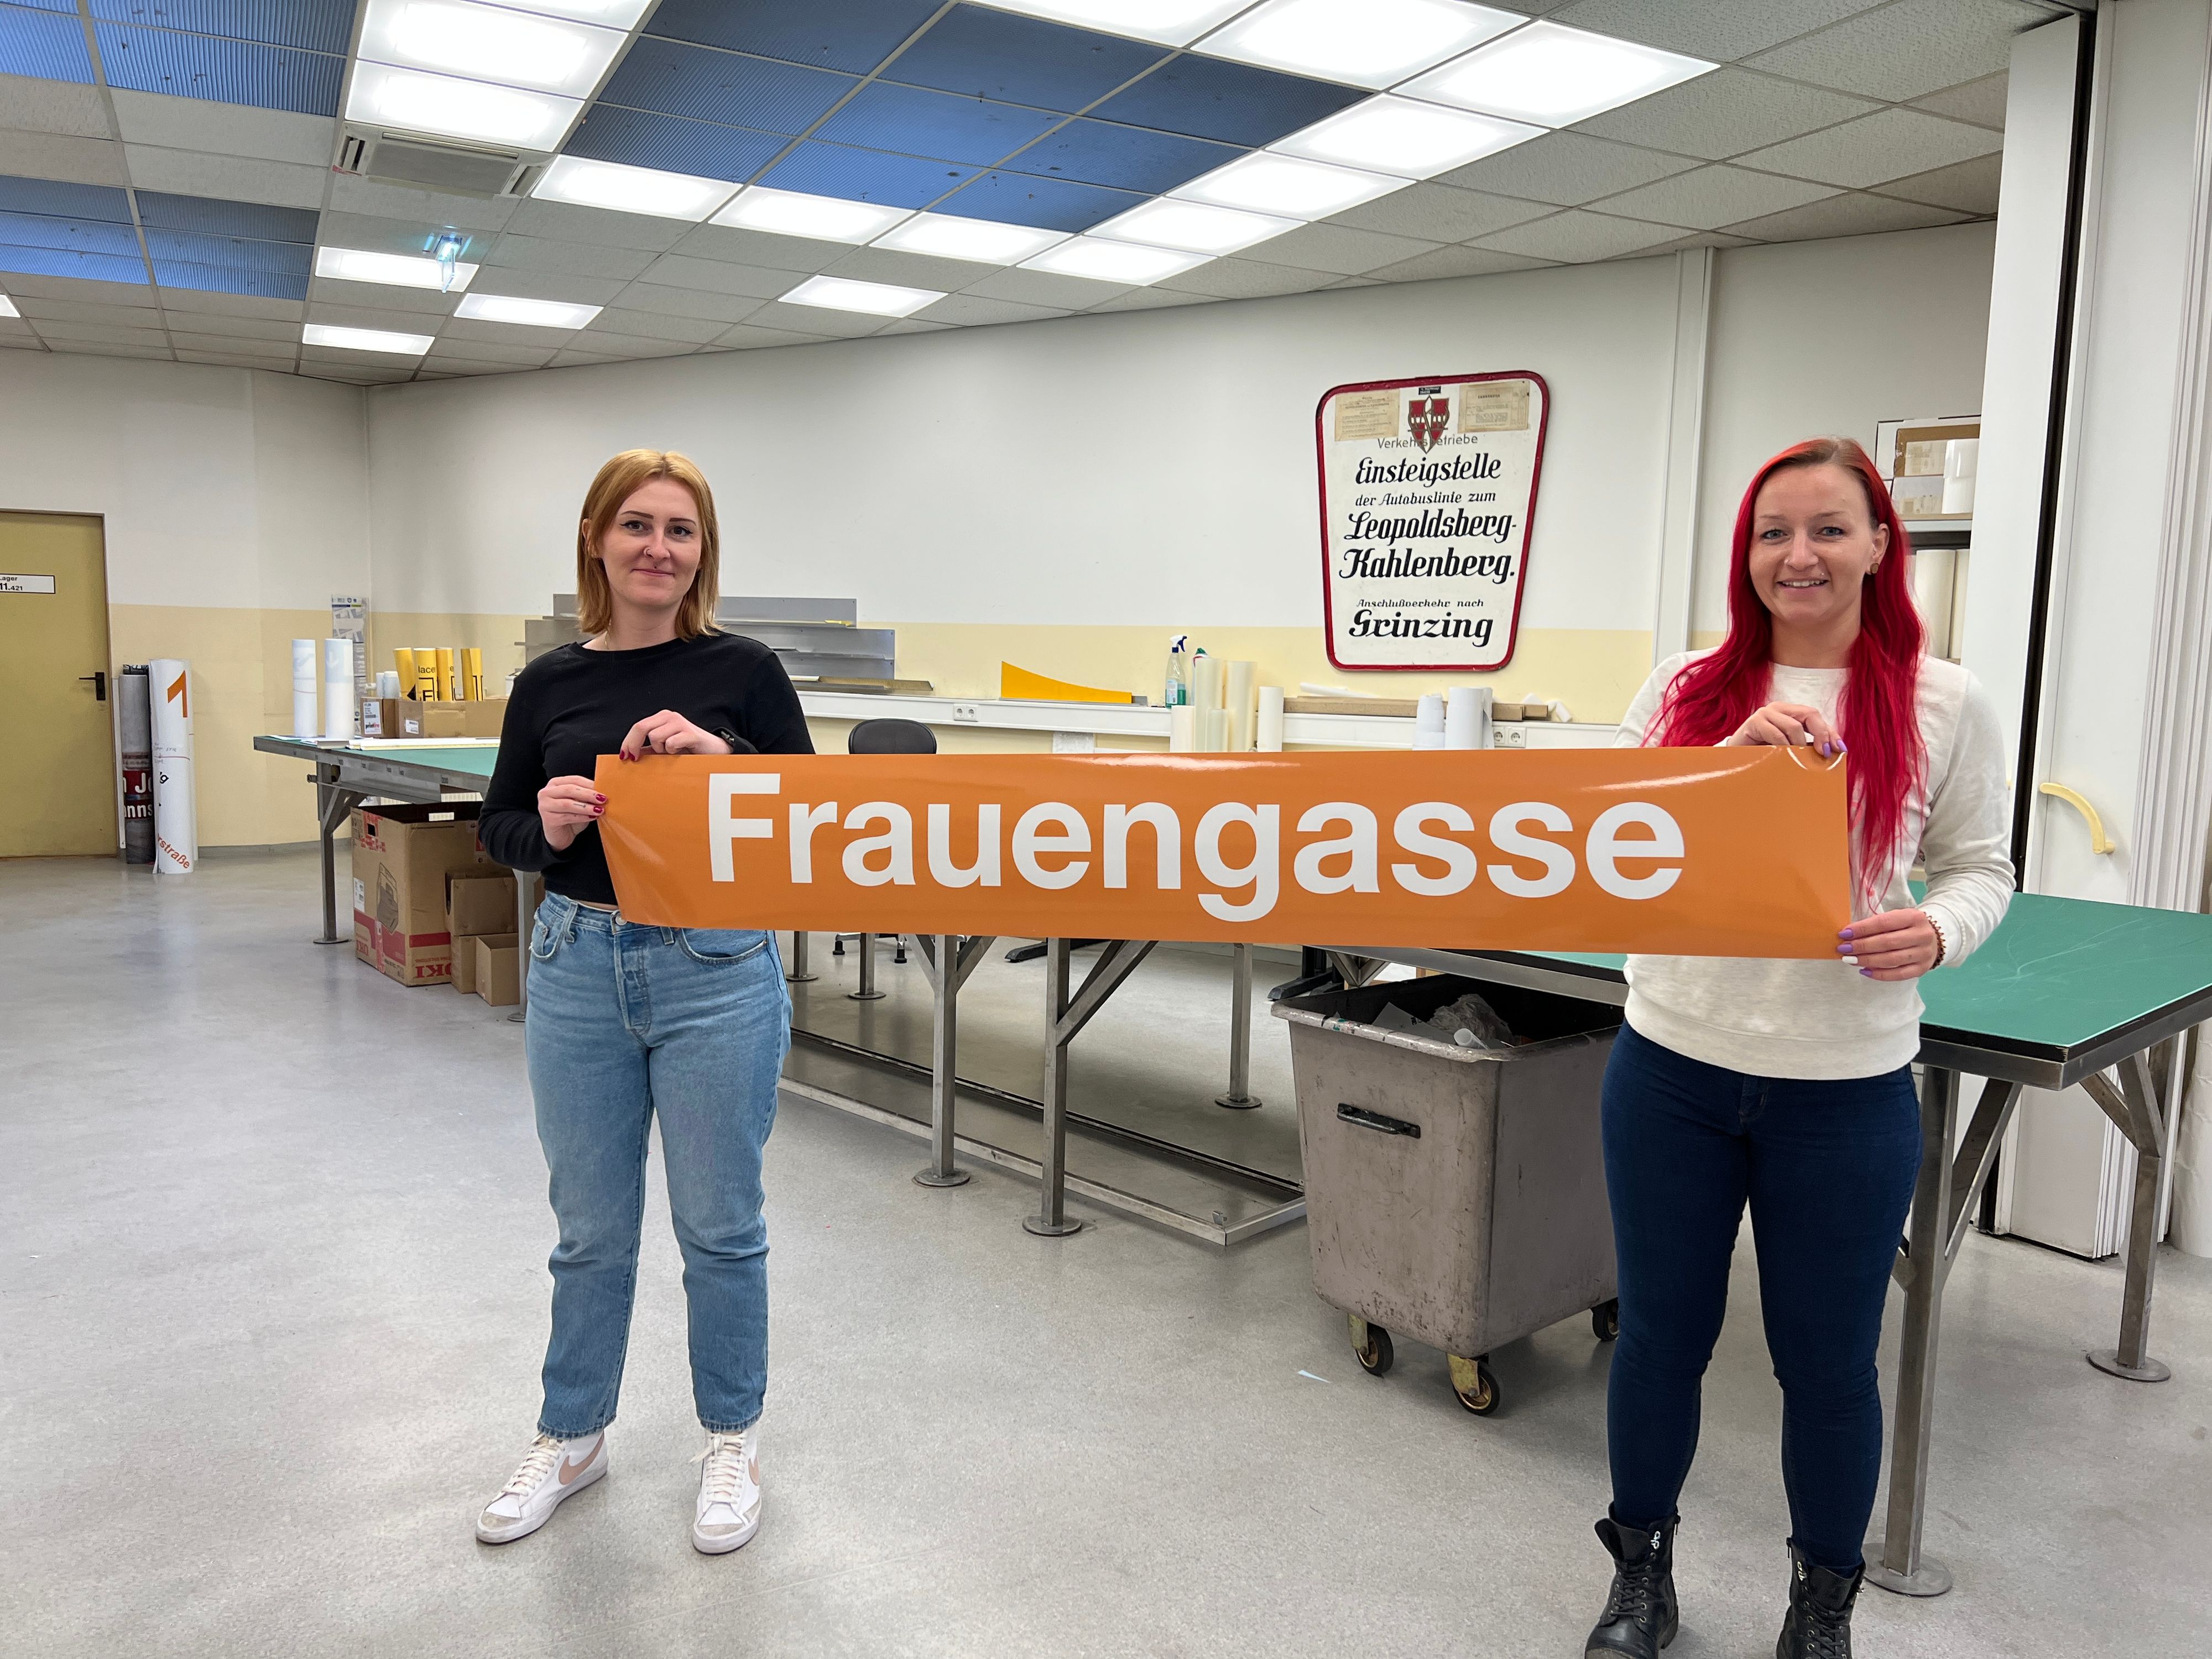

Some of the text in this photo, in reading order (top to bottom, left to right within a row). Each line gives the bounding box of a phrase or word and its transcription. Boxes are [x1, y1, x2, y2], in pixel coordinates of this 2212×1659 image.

[1355, 453, 1501, 488] Einsteigstelle
[1355, 491, 1496, 507] der Autobuslinie zum
[1344, 508, 1516, 546] Leopoldsberg-
[1339, 547, 1515, 585] Kahlenberg.
[1356, 598, 1484, 608] Anschlußverkehr nach
[1349, 609, 1493, 648] Grinzing
[708, 773, 1685, 922] Frauengasse
